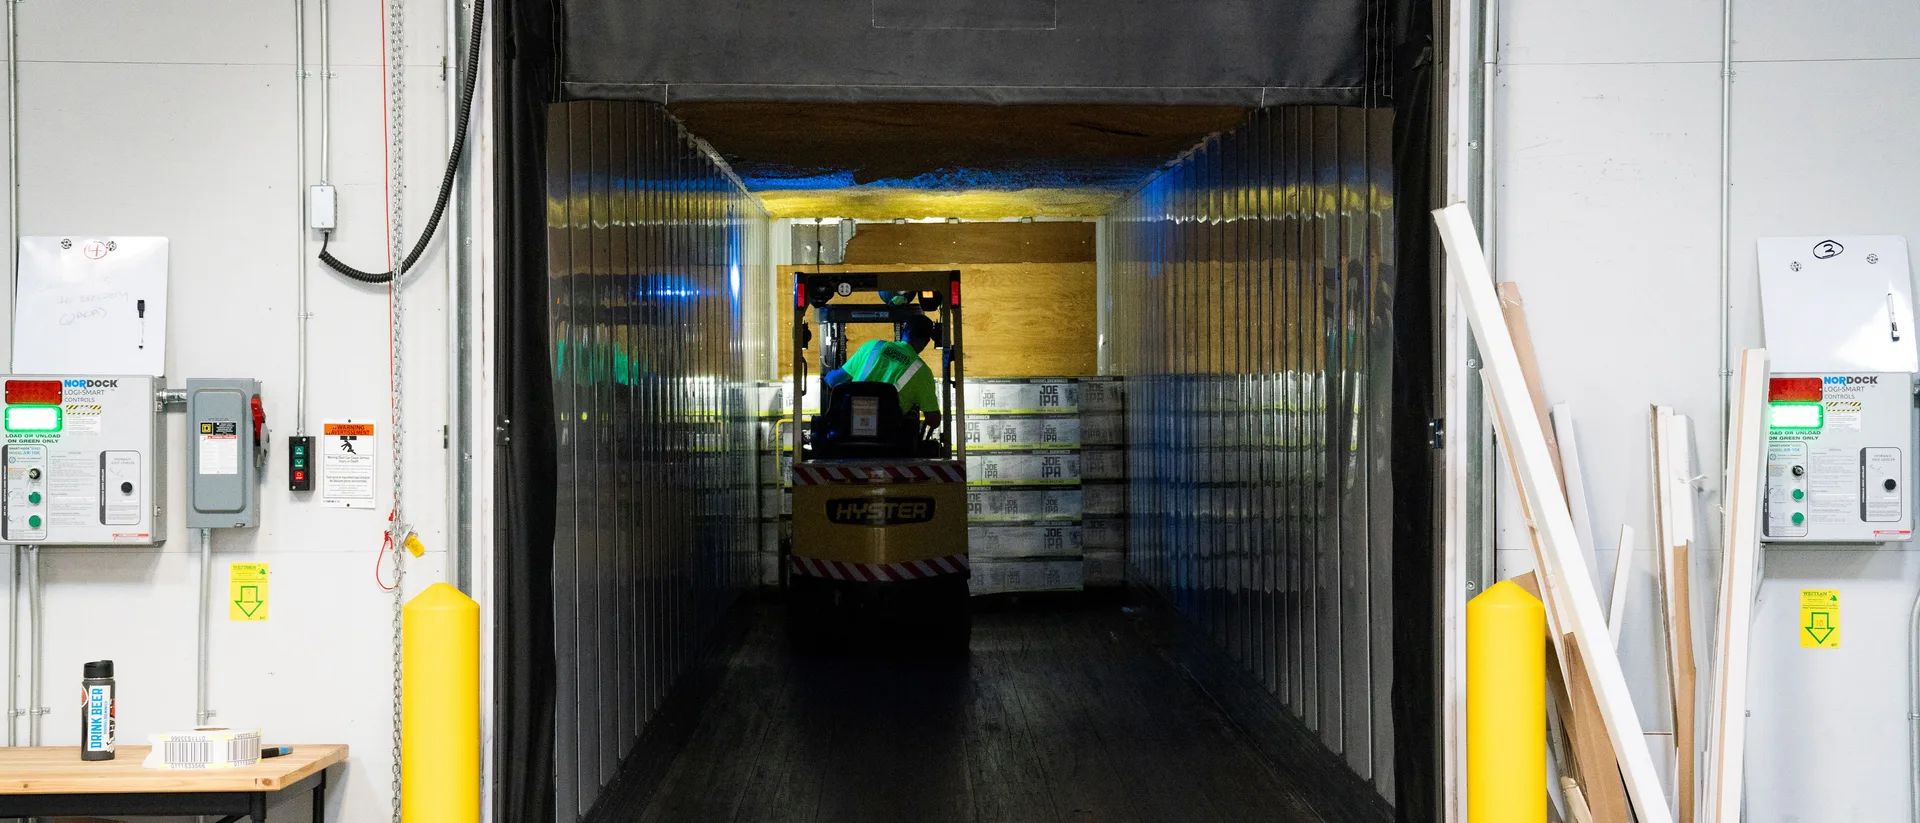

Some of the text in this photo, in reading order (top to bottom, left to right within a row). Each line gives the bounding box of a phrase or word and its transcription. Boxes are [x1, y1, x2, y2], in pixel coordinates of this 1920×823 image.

[1823, 244, 1836, 257] 3
[64, 380, 118, 389] NORDOCK
[1824, 376, 1878, 386] NORDOCK
[1039, 385, 1058, 394] JOE
[1039, 395, 1058, 406] IPA
[965, 422, 980, 431] OE
[966, 432, 980, 442] PA
[1042, 457, 1060, 466] JOE
[1042, 466, 1061, 477] IPA
[836, 503, 927, 520] HYSTER
[968, 503, 982, 514] PA
[1044, 528, 1062, 537] JOE
[1044, 538, 1062, 549] IPA
[91, 688, 103, 749] DRINK BEER
